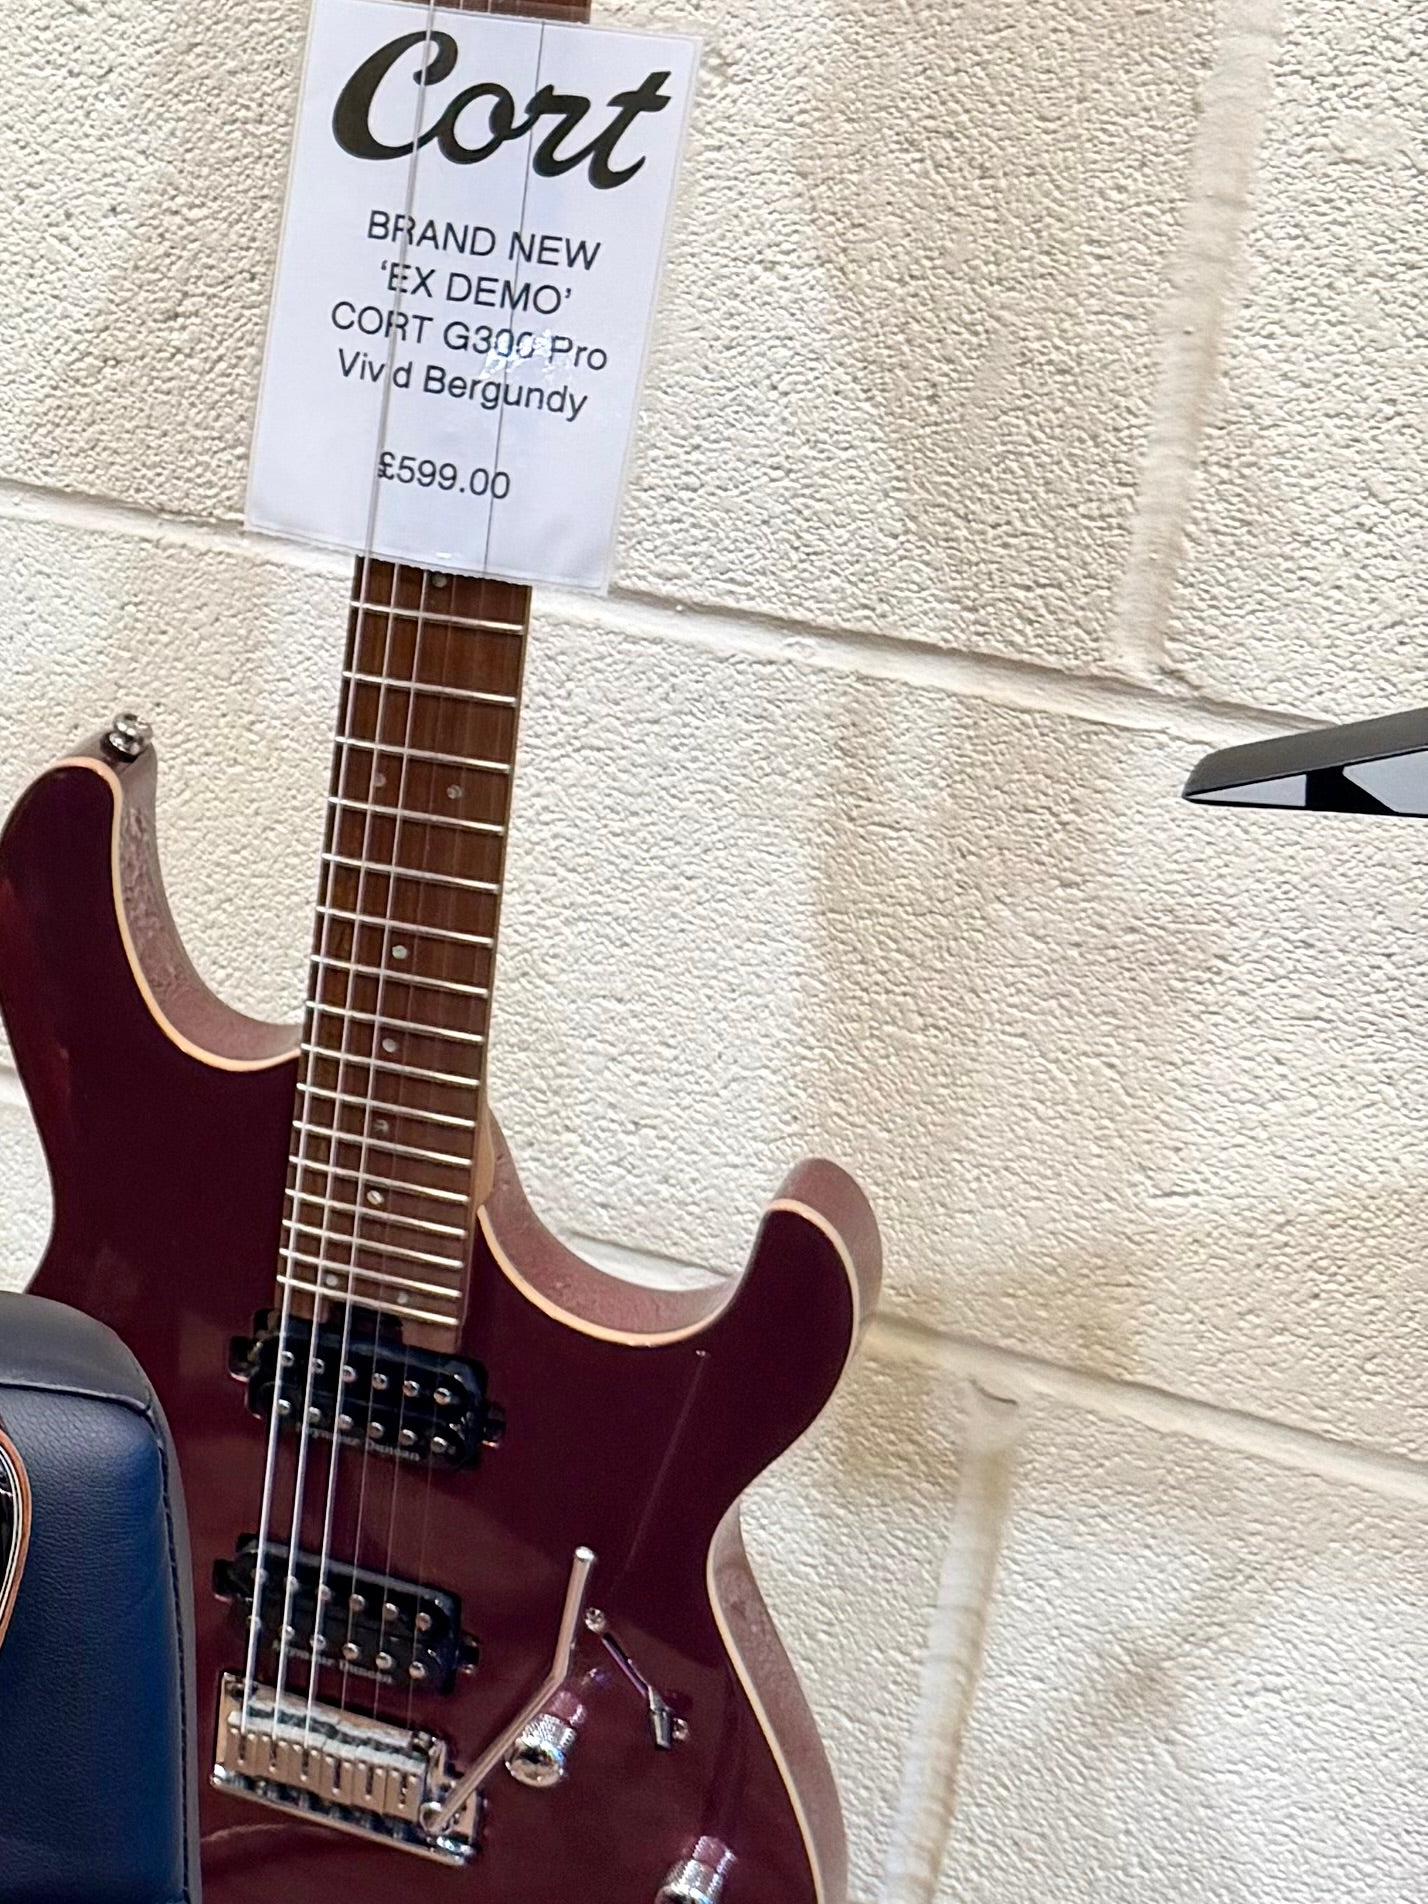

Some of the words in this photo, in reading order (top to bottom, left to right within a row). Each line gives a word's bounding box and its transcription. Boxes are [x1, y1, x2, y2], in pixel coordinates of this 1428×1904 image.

[332, 31, 671, 190] Cort
[367, 209, 496, 258] BRAND
[508, 231, 601, 272] NEW
[331, 301, 434, 348] CORT
[545, 335, 608, 372] Pro
[336, 348, 412, 392] Vivd
[422, 357, 588, 424] Bergundy
[377, 451, 511, 500] £599.00
